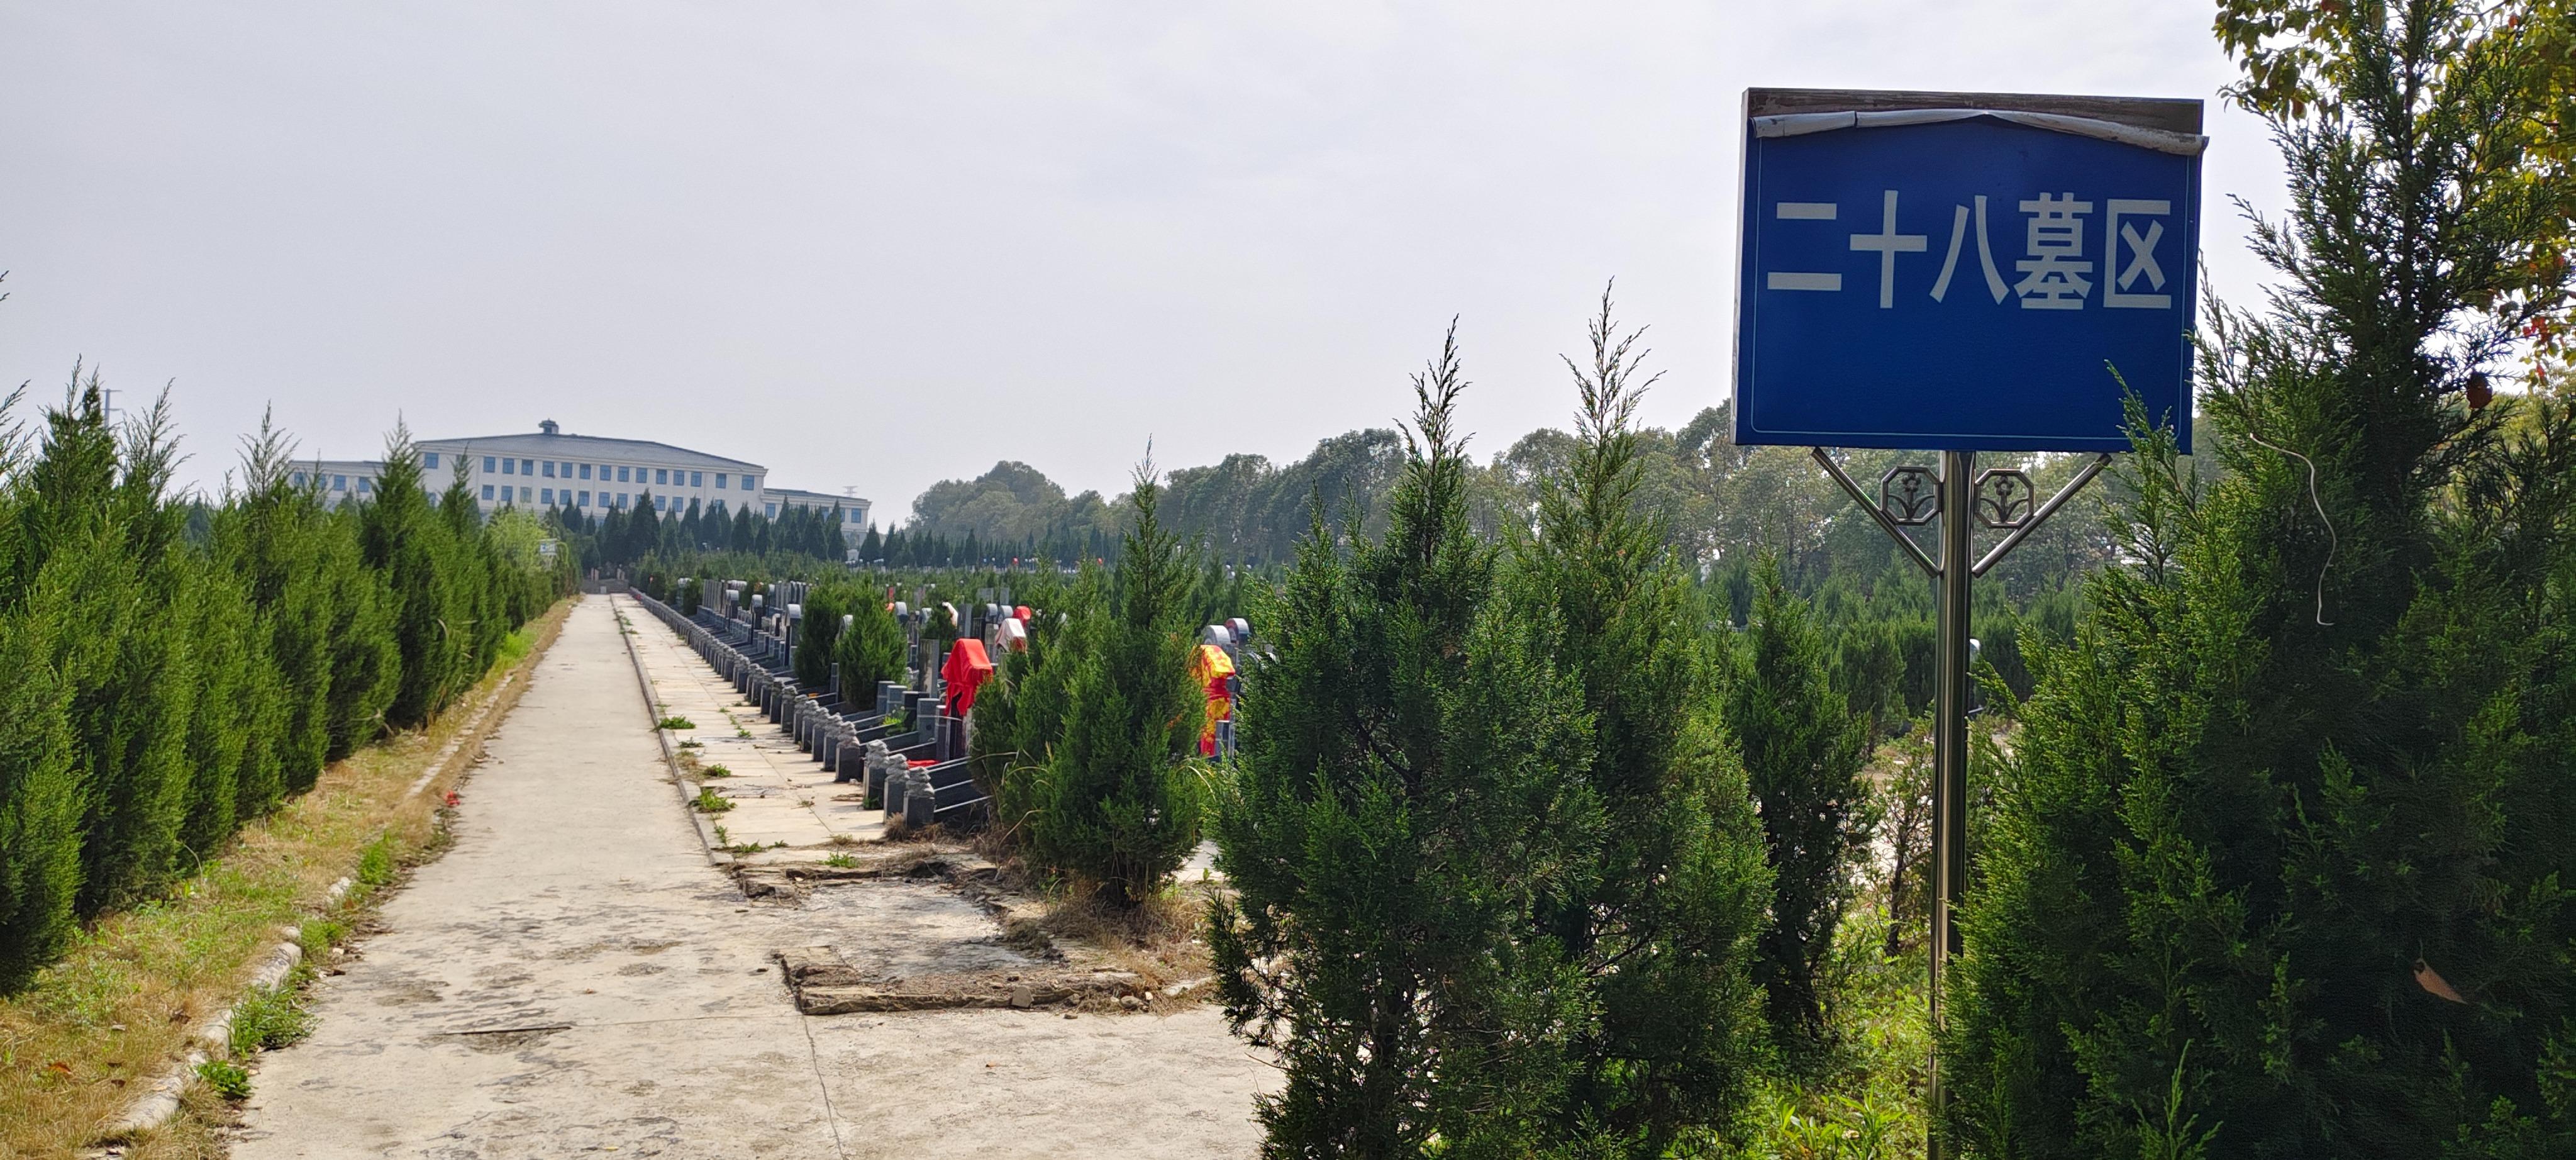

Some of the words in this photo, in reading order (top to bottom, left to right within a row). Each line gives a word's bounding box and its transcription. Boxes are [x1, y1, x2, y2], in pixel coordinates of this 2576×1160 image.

[1767, 189, 2172, 310] 二十八墓区
